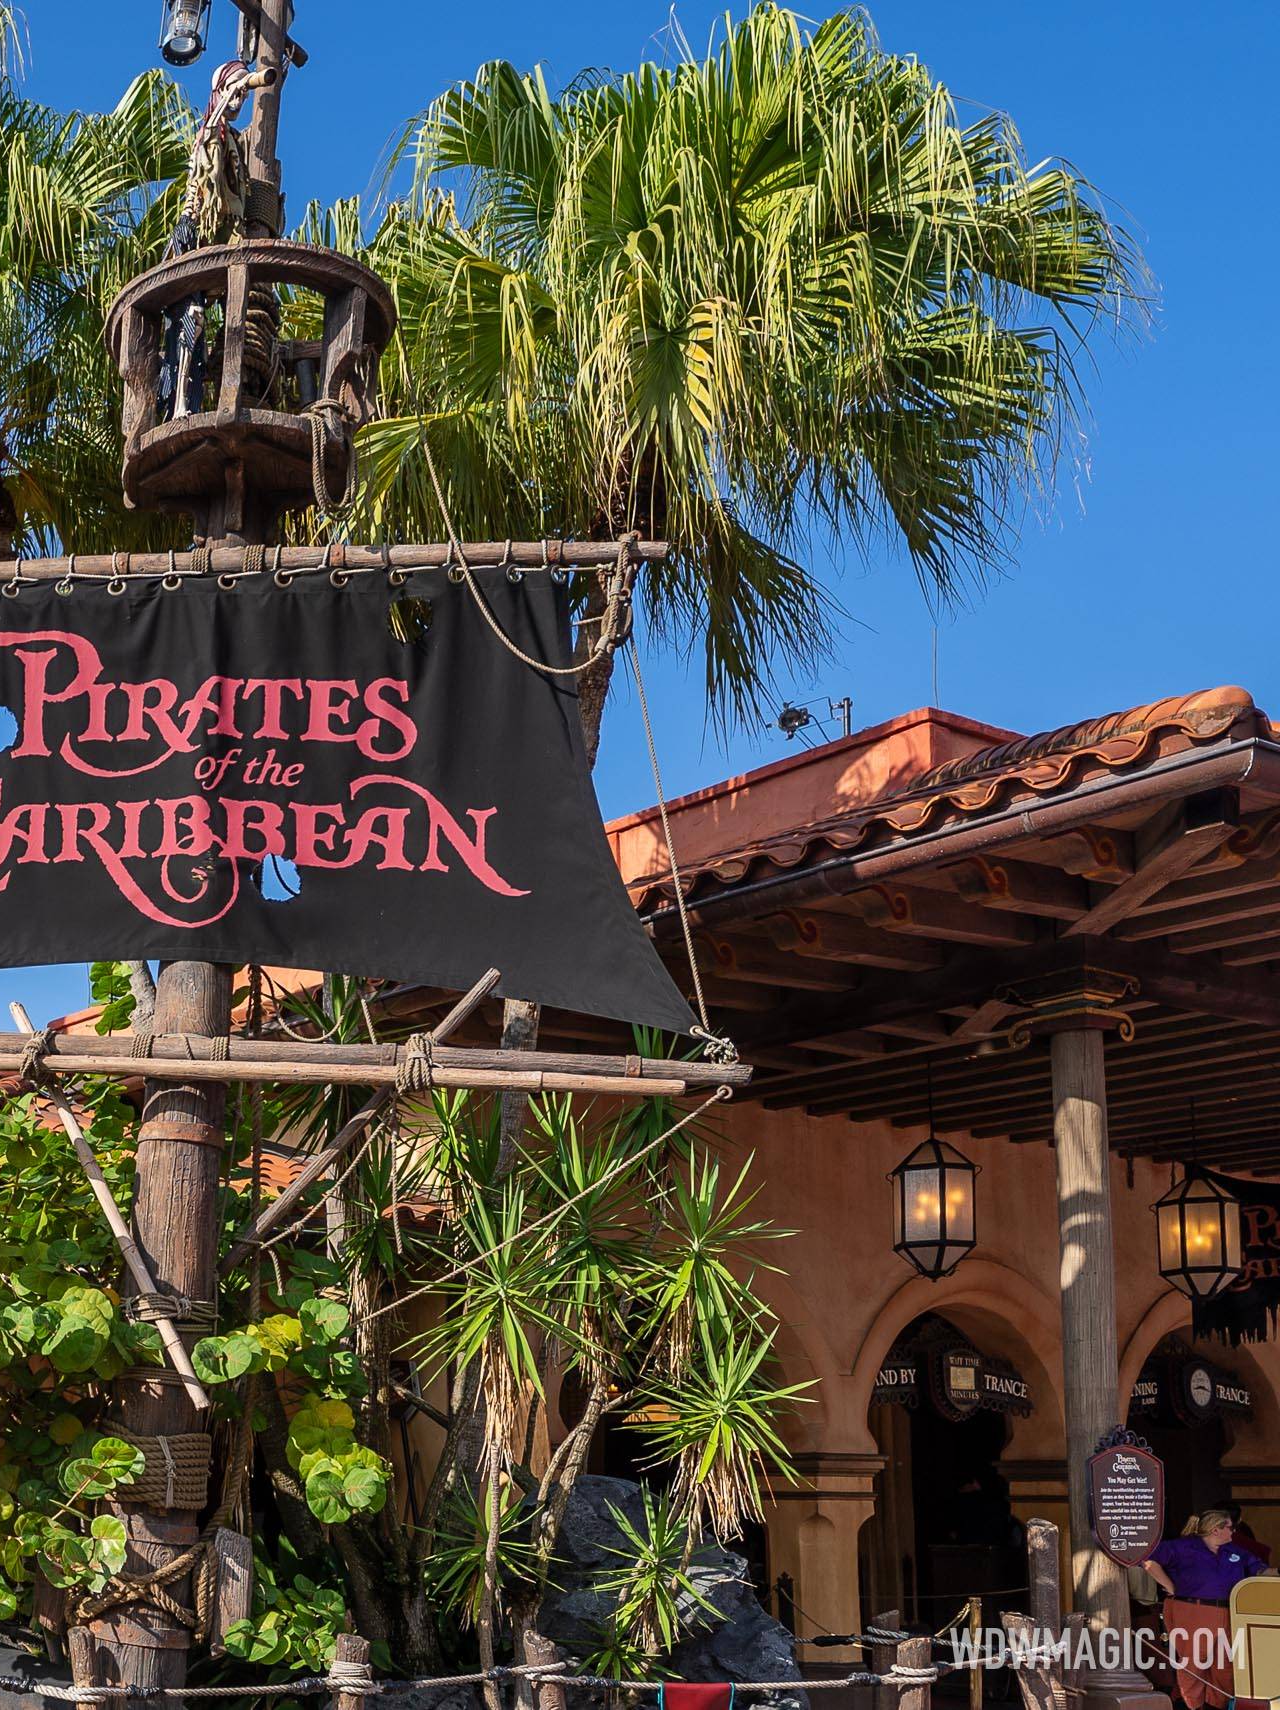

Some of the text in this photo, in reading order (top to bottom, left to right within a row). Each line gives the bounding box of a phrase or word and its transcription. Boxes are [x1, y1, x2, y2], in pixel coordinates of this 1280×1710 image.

[193, 750, 306, 791] of the
[900, 1368, 917, 1384] BY
[984, 1374, 1028, 1398] TRANCE
[1131, 1382, 1158, 1397] NING
